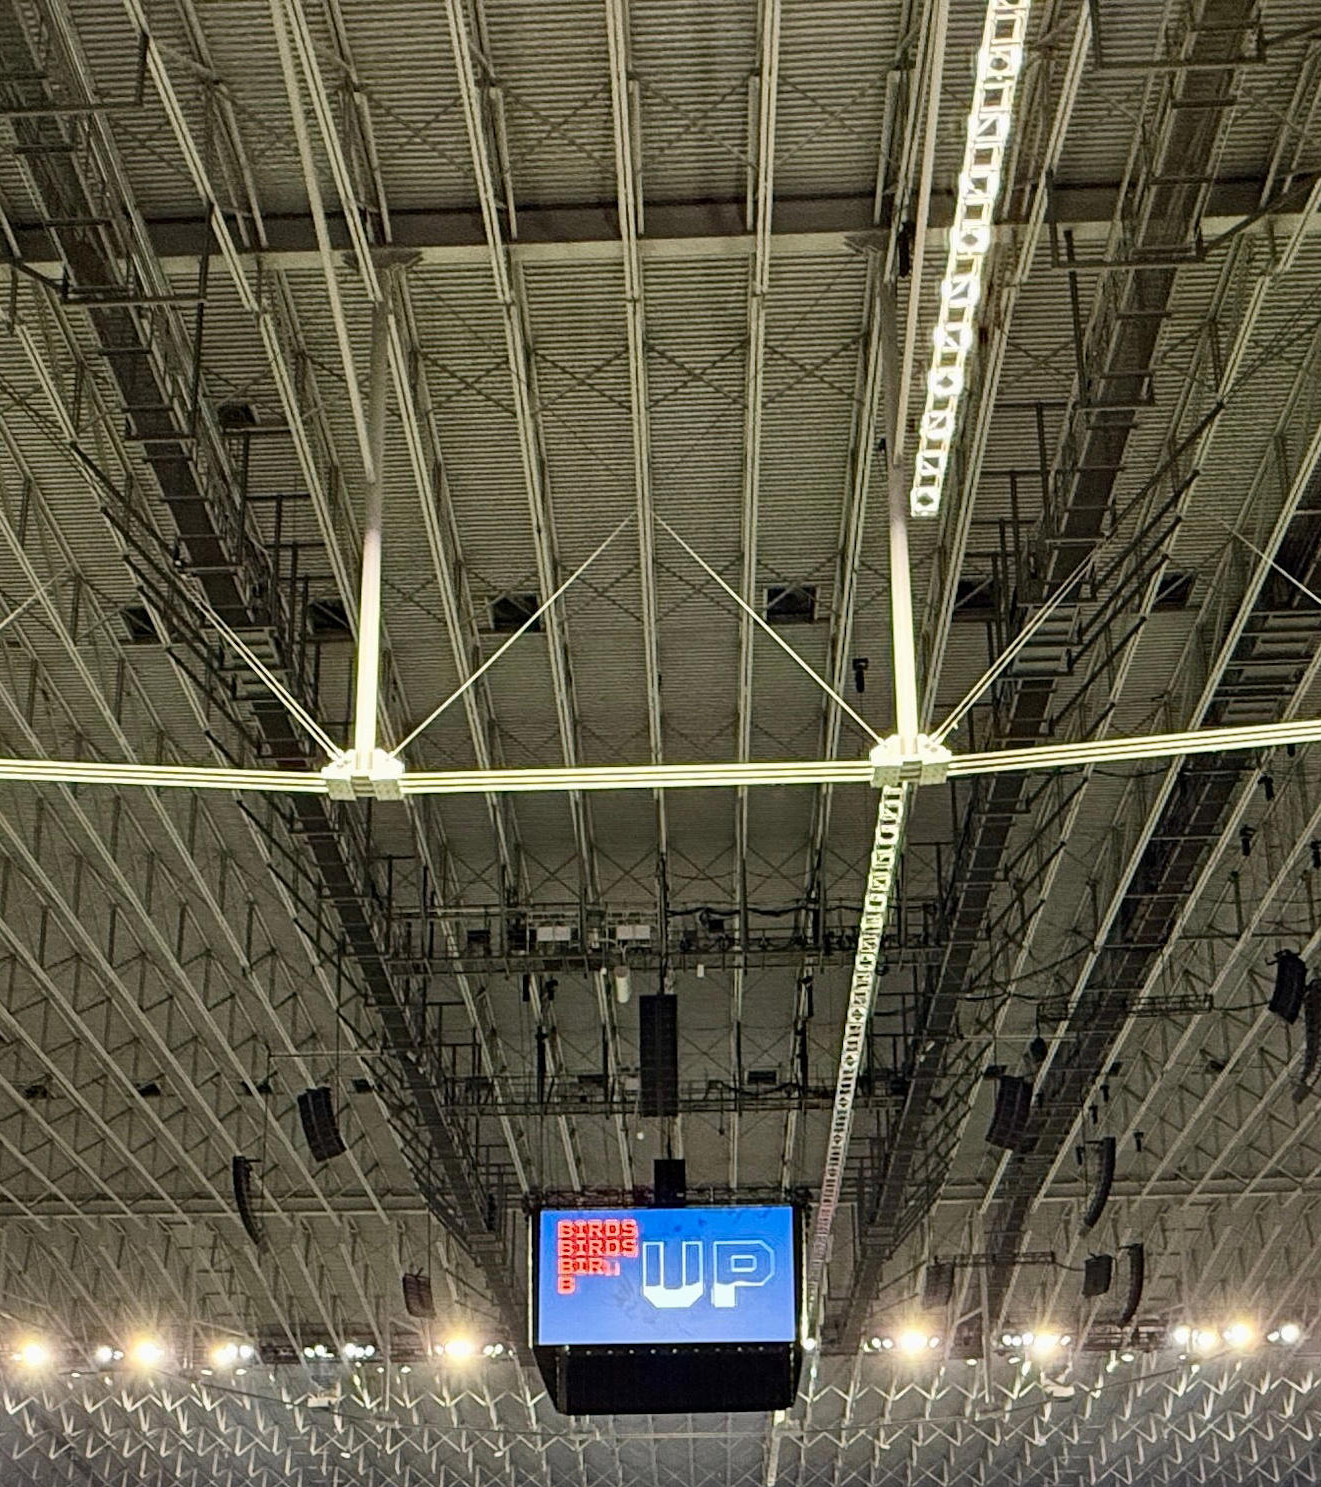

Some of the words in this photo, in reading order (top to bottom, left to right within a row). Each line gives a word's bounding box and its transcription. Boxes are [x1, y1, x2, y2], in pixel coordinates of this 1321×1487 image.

[557, 1219, 639, 1238] BIRDS
[557, 1238, 639, 1257] BIRDS
[642, 1240, 776, 1309] UP
[557, 1276, 576, 1295] B
